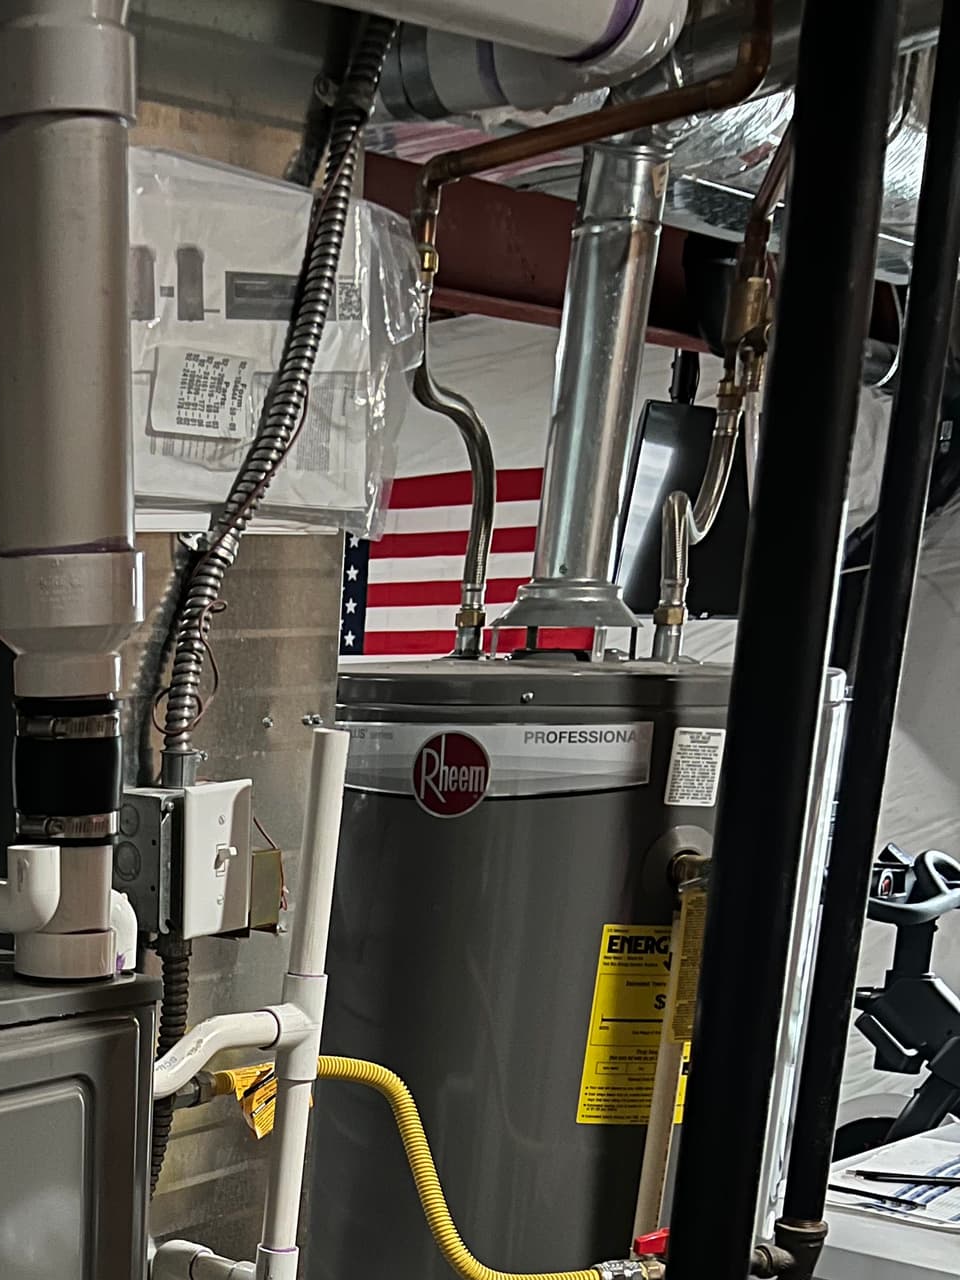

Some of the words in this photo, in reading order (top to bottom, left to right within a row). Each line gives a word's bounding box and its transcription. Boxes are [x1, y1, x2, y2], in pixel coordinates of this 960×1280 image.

[524, 730, 638, 744] PROFESSIONA
[419, 733, 486, 804] Rheem
[607, 935, 672, 954] ENERG
